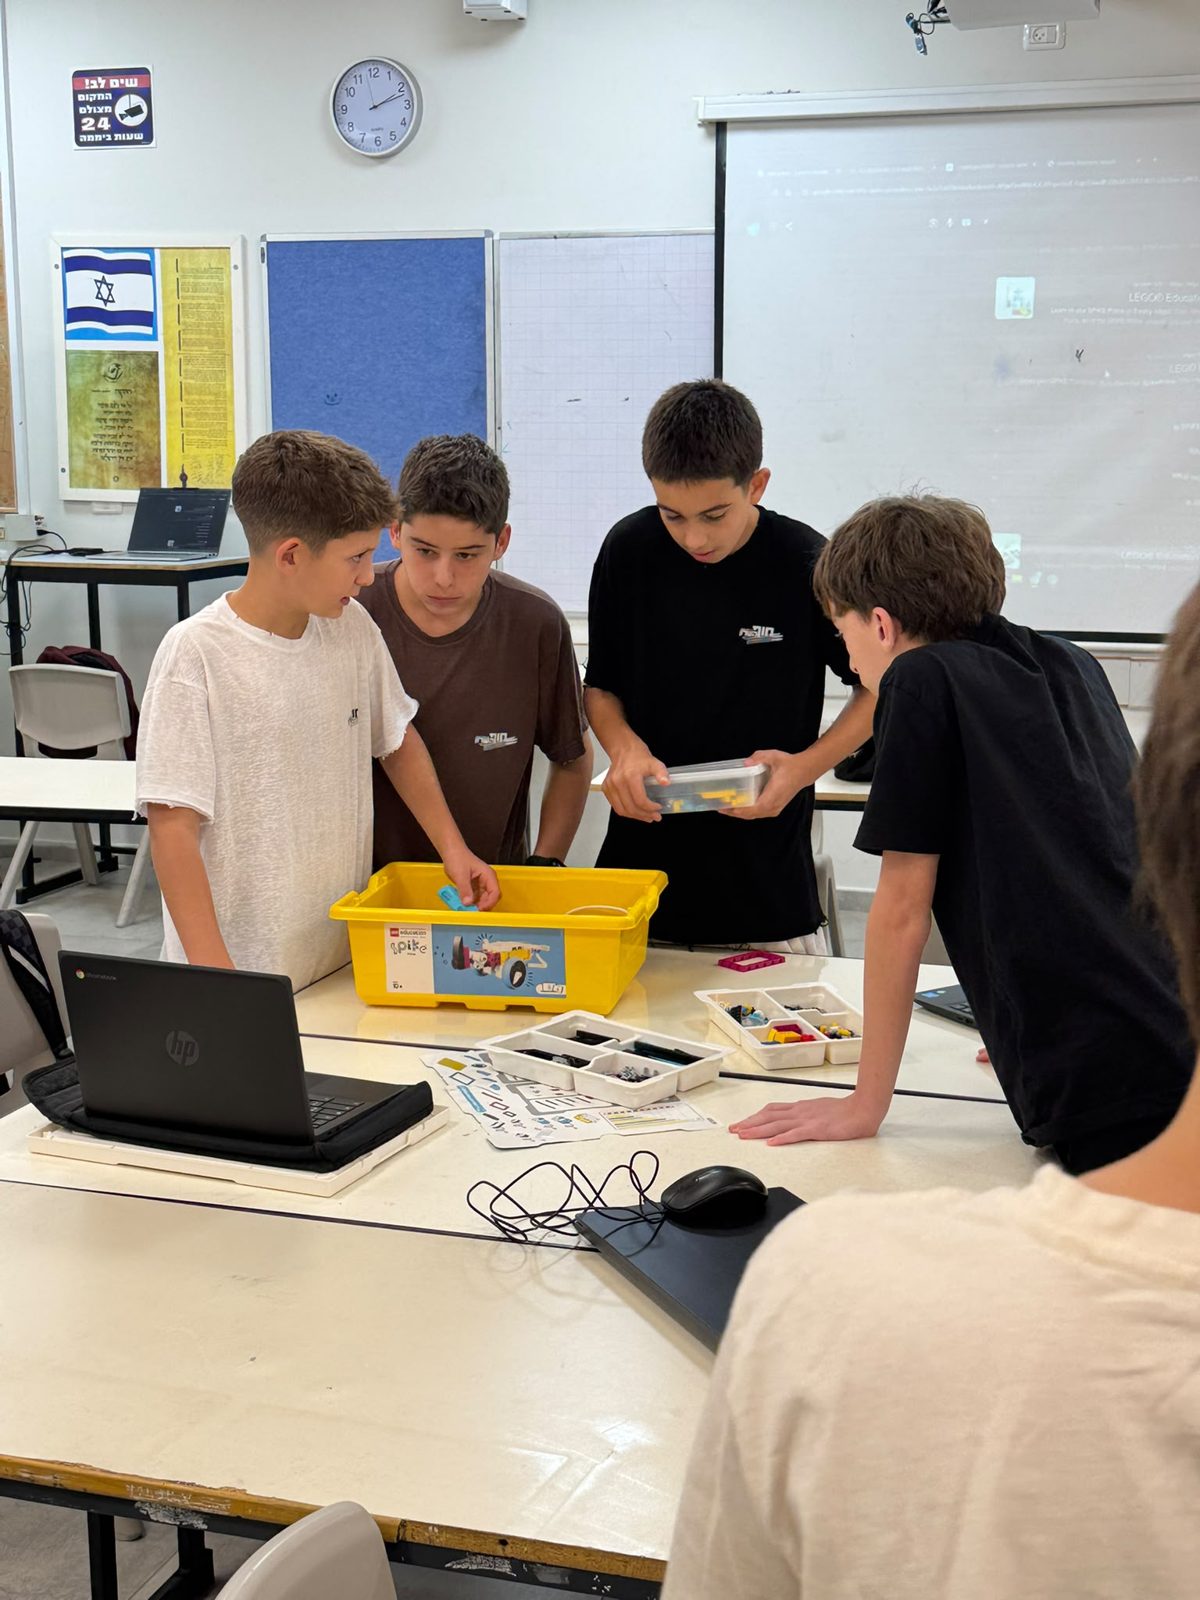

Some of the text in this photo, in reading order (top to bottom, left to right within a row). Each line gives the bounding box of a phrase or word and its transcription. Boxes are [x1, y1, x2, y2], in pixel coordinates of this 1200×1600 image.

[368, 67, 380, 78] 12
[387, 71, 392, 80] 1
[84, 77, 138, 89] שים לב!
[353, 74, 363, 84] 11
[345, 86, 356, 97] 10
[397, 82, 405, 93] 2
[77, 93, 112, 102] המקום
[79, 105, 112, 114] מצולם
[404, 99, 411, 110] 3
[341, 105, 348, 115] 9
[81, 117, 111, 131] 24
[347, 121, 354, 132] 8
[400, 117, 407, 127] 4
[79, 132, 144, 142] שעות ביממה
[359, 133, 366, 143] 7
[389, 131, 397, 141] 5
[374, 136, 382, 147] 6
[170, 1030, 197, 1066] hp
